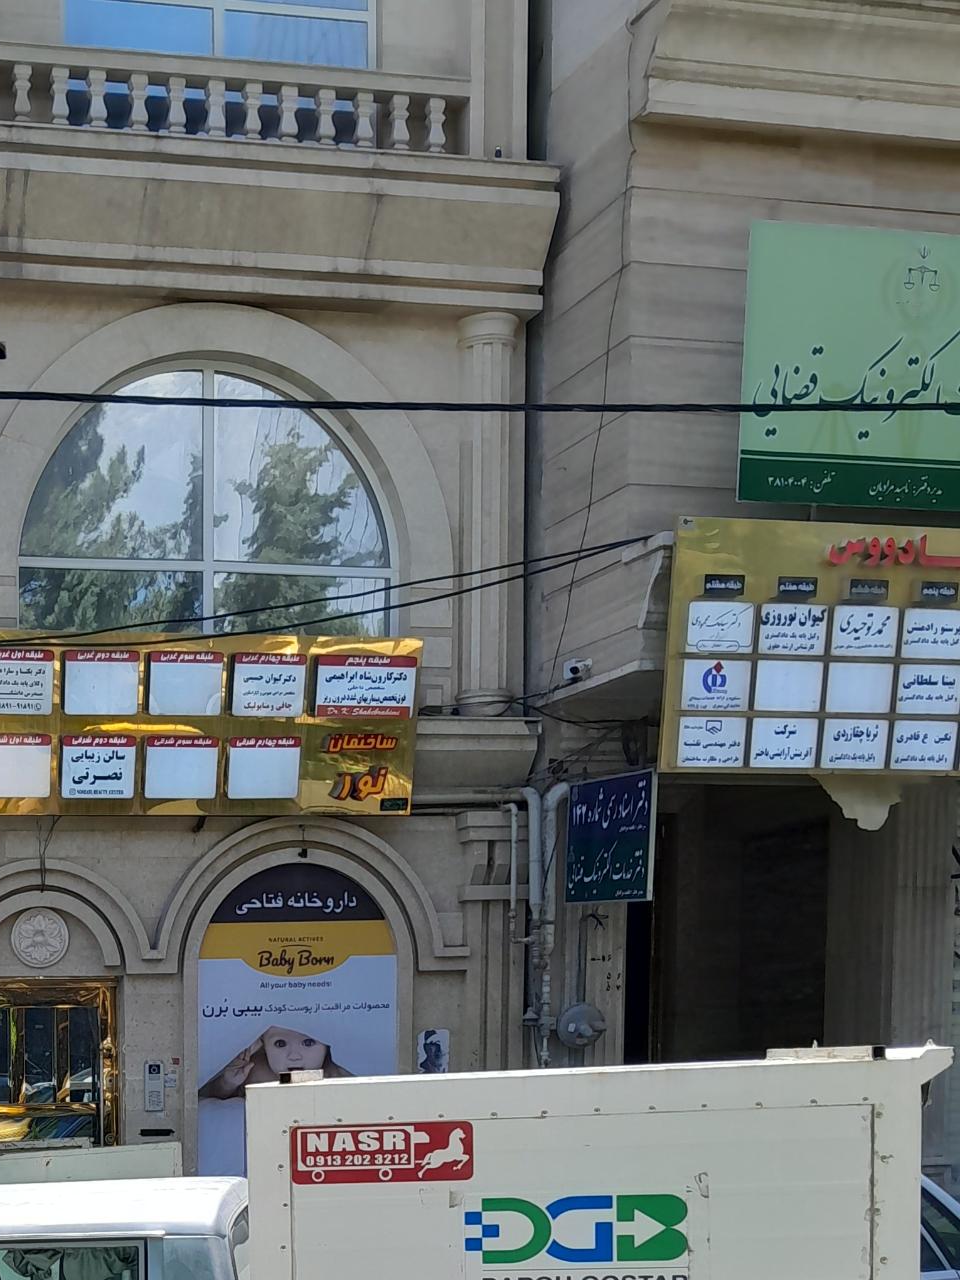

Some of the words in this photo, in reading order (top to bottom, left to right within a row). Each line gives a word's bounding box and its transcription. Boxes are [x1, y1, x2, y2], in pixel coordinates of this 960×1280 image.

[760, 606, 798, 628] نوروزی
[798, 607, 827, 628] کیوان
[839, 612, 875, 641] توحیدی
[871, 615, 892, 636] محمد
[25, 651, 44, 660] طبقه
[282, 674, 297, 685] دکتر
[391, 671, 408, 684] دکتر
[902, 674, 939, 690] سلطانی
[774, 724, 797, 739] شرکت
[896, 730, 920, 744] قادری
[326, 733, 398, 753] ساختمان
[70, 749, 101, 764] زیبایی
[103, 749, 126, 763] سالن
[72, 767, 123, 785] نصرتی
[332, 766, 388, 801] نور
[235, 892, 284, 915] فتاحی
[286, 891, 357, 914] داروخانه
[258, 949, 295, 974] Baby
[298, 952, 335, 968] Born
[270, 982, 287, 990] your
[288, 981, 307, 990] baby
[264, 1001, 287, 1013] کودک
[287, 1002, 313, 1015] پوست
[321, 1001, 351, 1012] مراقبت
[352, 1000, 390, 1011] محصولات
[306, 1130, 407, 1153] NASR
[305, 1154, 342, 1167] 0913
[345, 1153, 372, 1167] 202
[374, 1152, 409, 1166] 3212
